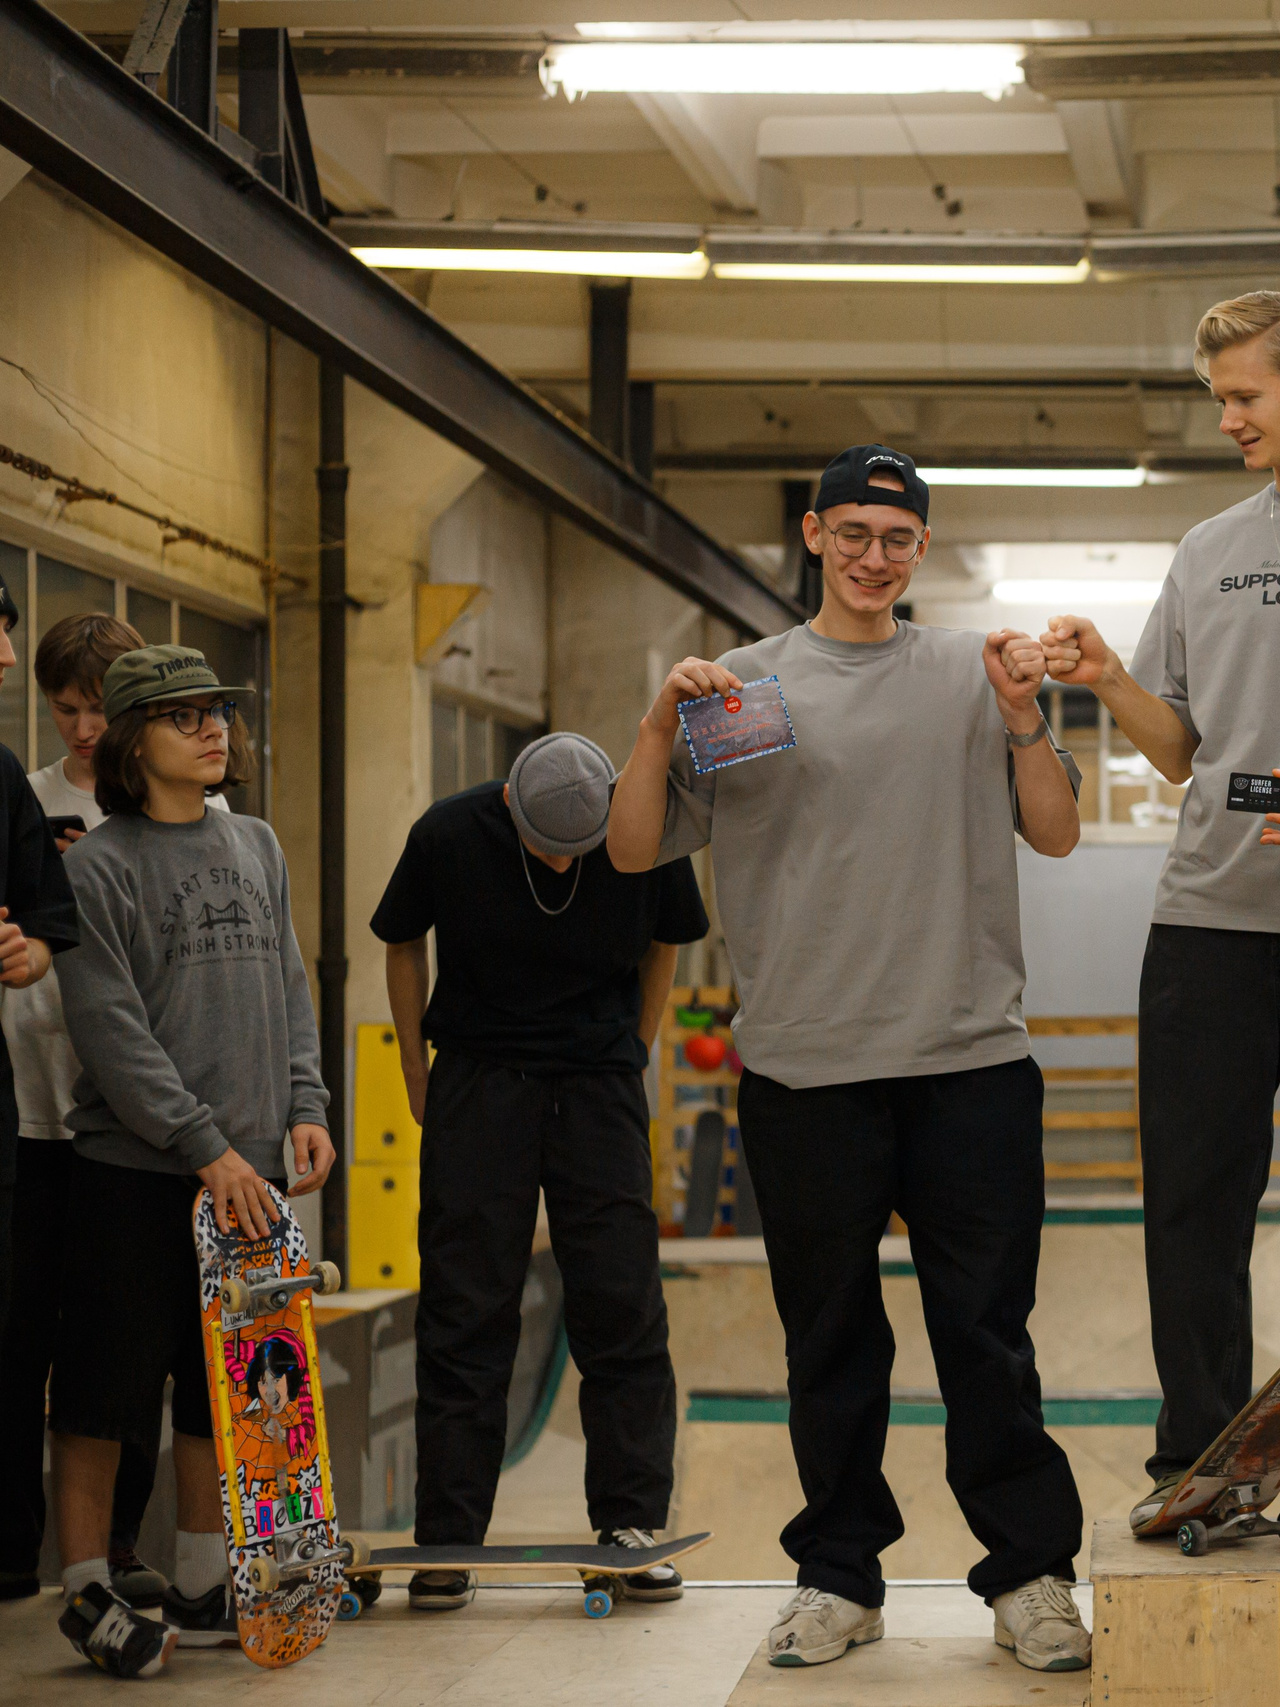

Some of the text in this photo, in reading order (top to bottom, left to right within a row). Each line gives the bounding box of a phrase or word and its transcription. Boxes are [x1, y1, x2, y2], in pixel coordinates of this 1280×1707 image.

[1250, 779, 1272, 787] SURFER
[1250, 786, 1272, 794] LICENSE
[160, 868, 272, 935] START STRONG
[165, 937, 215, 966] FINISH
